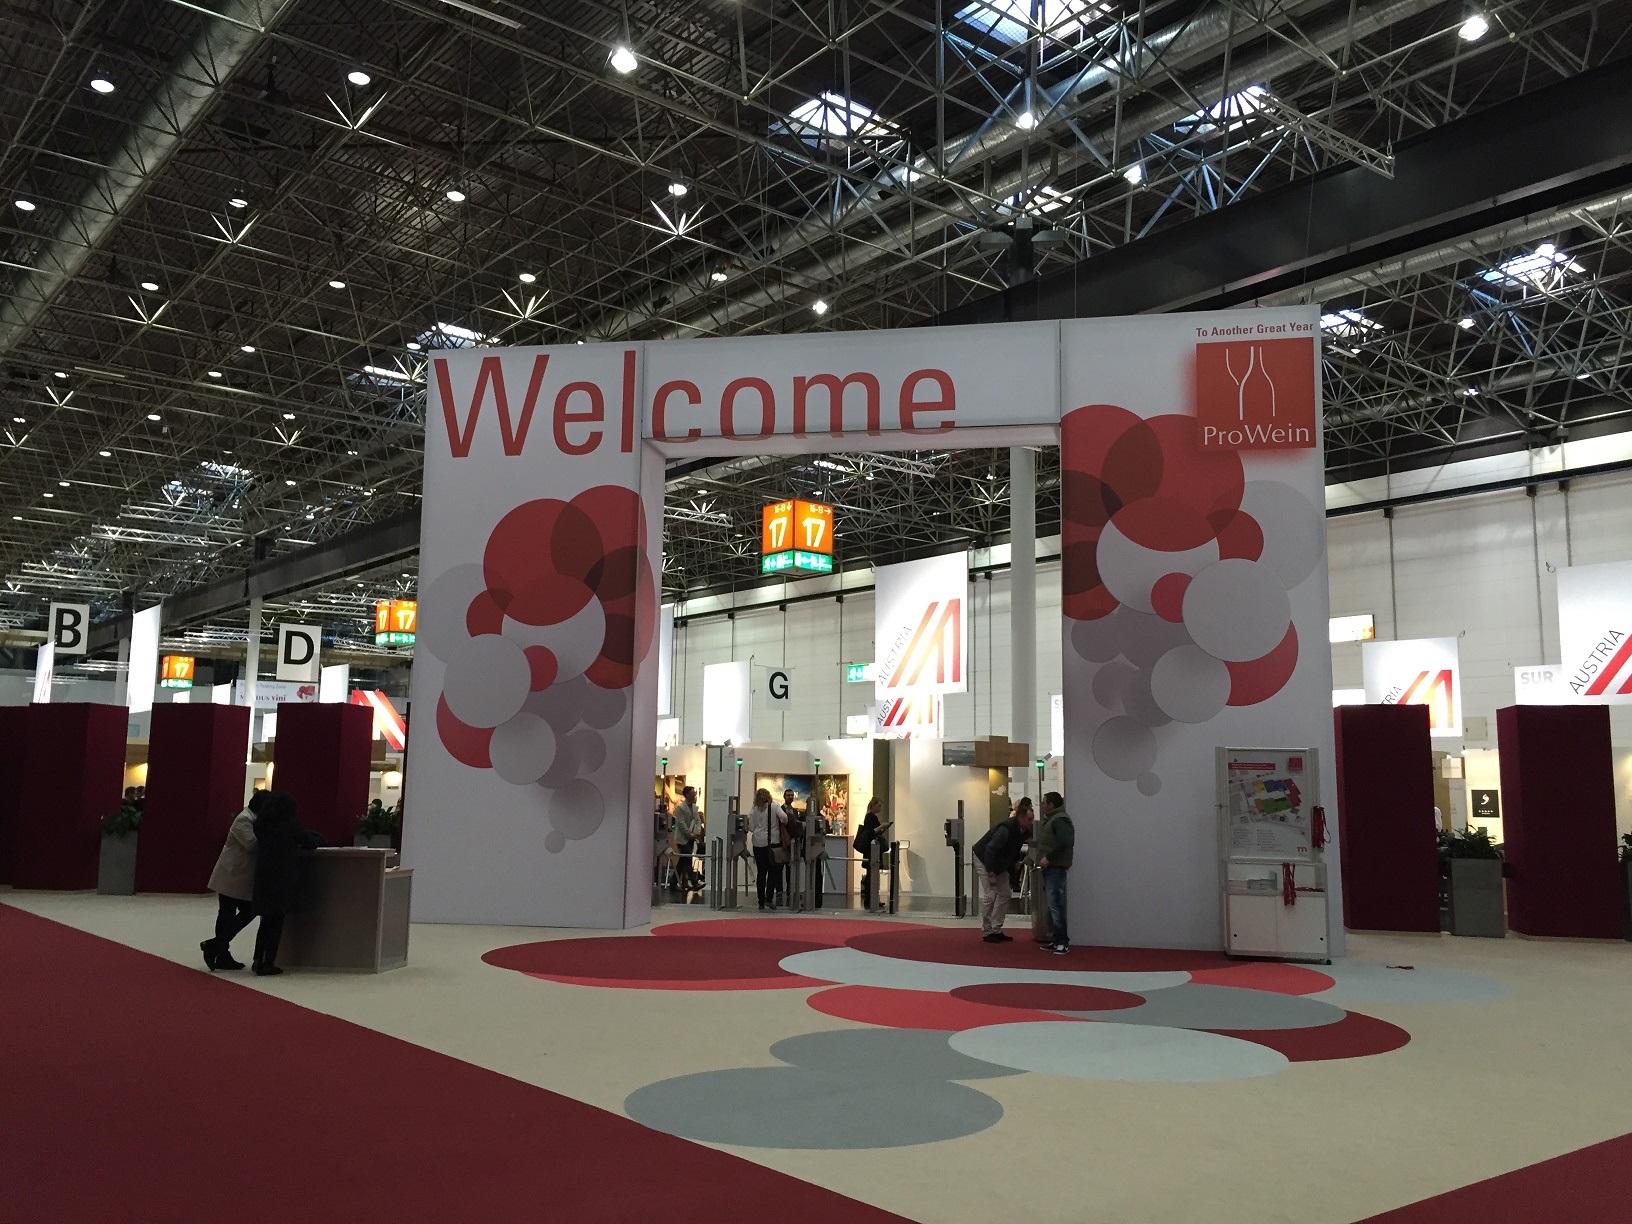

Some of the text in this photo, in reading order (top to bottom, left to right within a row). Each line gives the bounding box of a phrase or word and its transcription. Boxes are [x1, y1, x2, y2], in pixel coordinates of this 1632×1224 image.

[1196, 322, 1314, 338] To Another Great Year
[433, 350, 957, 459] Welcome
[1203, 422, 1310, 446] ProWein
[768, 516, 788, 548] 17
[801, 516, 826, 548] 17
[55, 608, 82, 649] B
[396, 609, 416, 630] 17
[284, 630, 315, 665] D
[877, 626, 913, 686] AUSTRIA
[1569, 628, 1625, 696] AUSTRIA
[173, 662, 190, 678] 17
[768, 671, 789, 700] G
[1520, 670, 1554, 685] SUR
